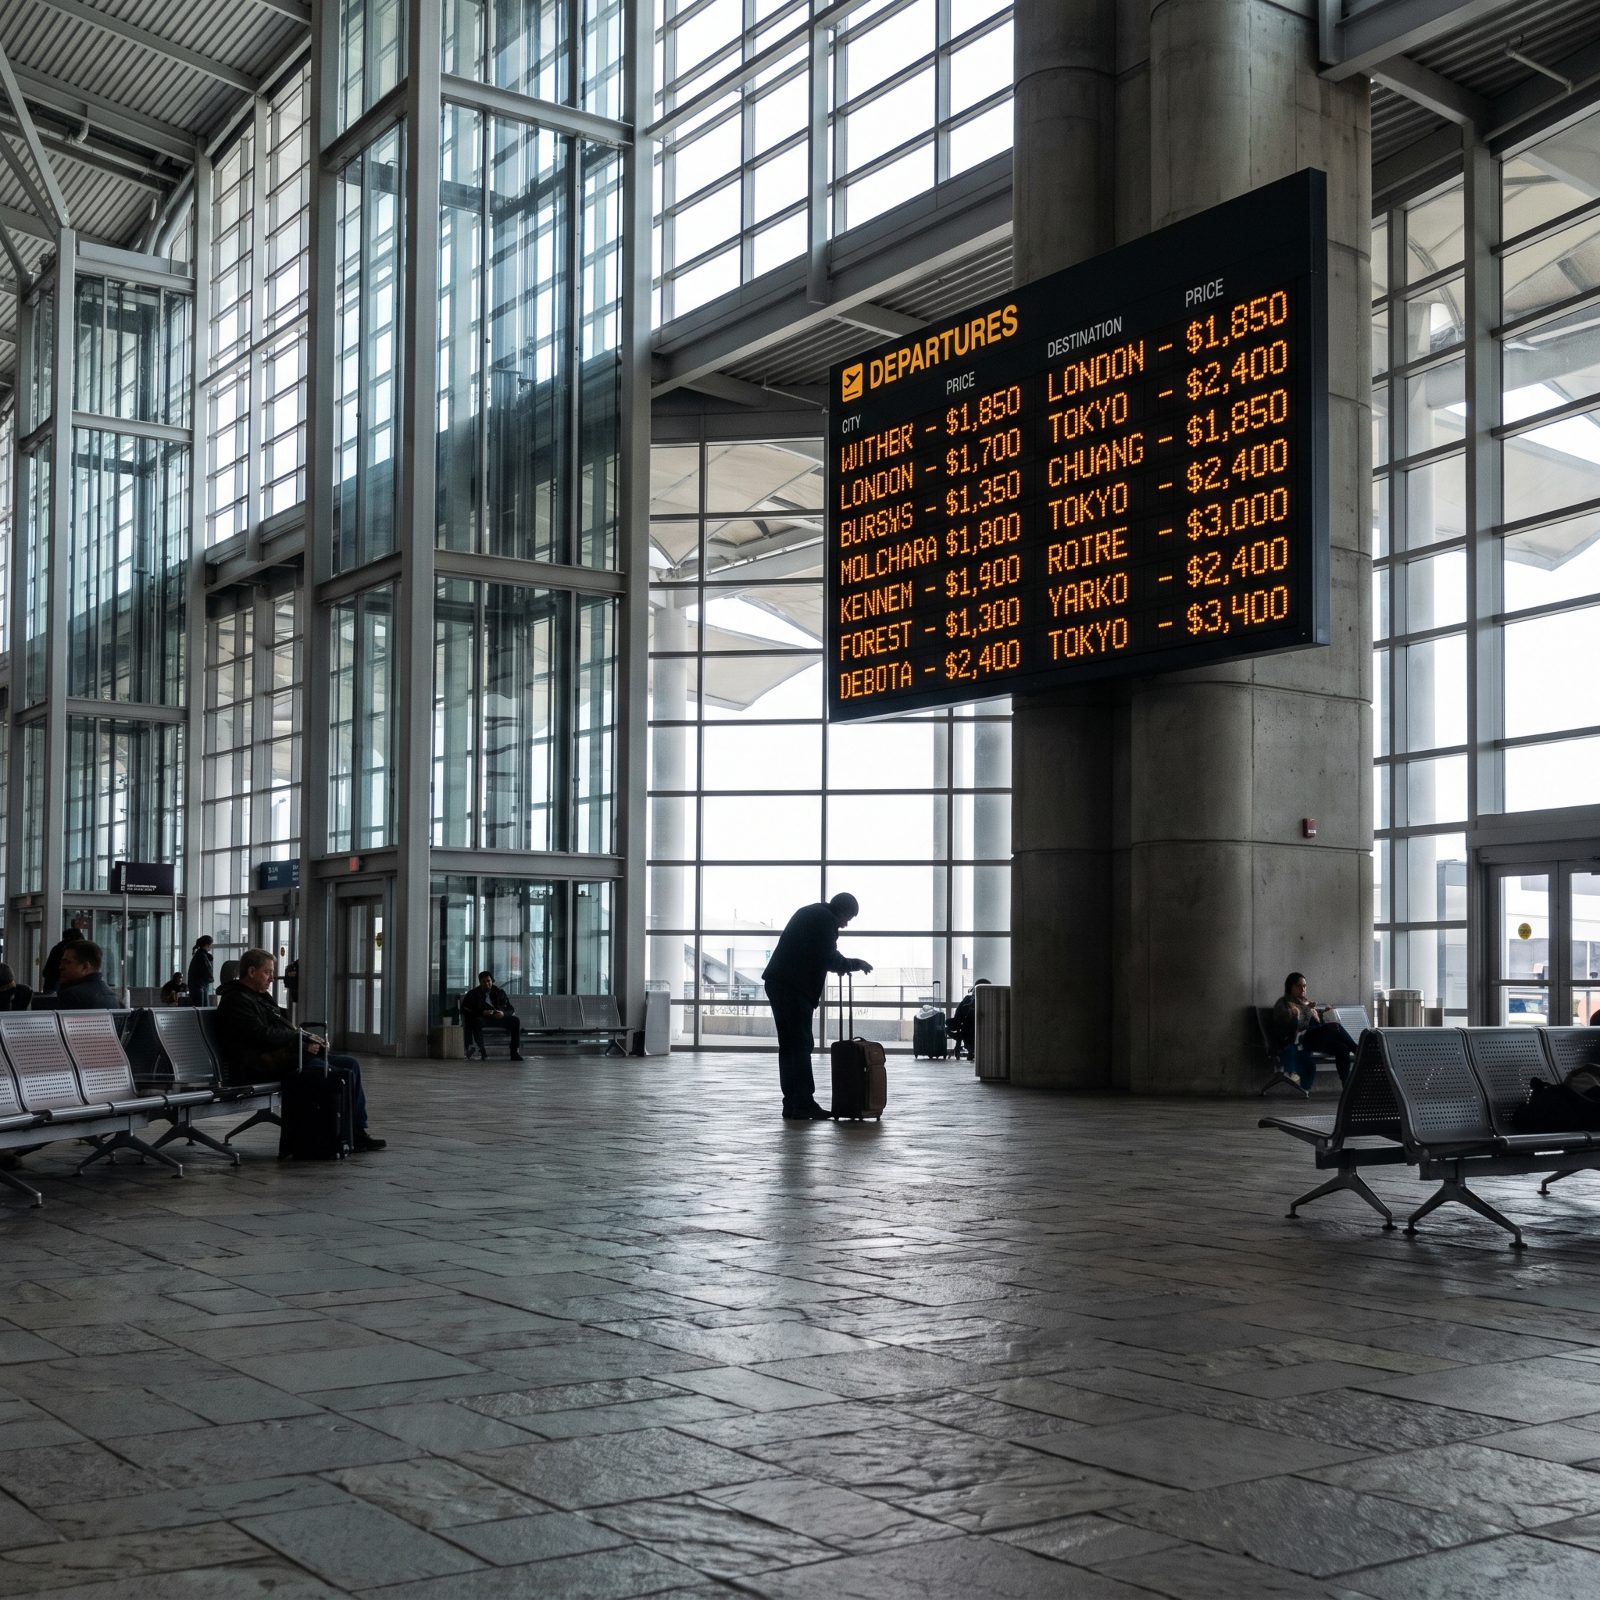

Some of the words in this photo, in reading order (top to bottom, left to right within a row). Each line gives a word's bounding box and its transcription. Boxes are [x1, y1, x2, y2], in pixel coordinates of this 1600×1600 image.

[870, 304, 1018, 389] DEPARTURES
[1048, 316, 1122, 358] DESTINATION
[1186, 278, 1224, 307] PRICE
[1049, 340, 1144, 402] LONDON
[1187, 291, 1287, 354] $1,850
[842, 415, 861, 433] CITY
[946, 371, 975, 395] PRICE
[946, 386, 1020, 435] $1,850
[1049, 392, 1127, 443] TOKYO
[1187, 340, 1287, 400] $2,400
[841, 462, 913, 509] LONDON
[946, 428, 1020, 476] $1,700
[1049, 433, 1144, 487] CHUANG
[1187, 389, 1287, 447] $1,850
[946, 470, 1020, 516] $1,350
[1049, 482, 1127, 529] TOKYO
[1187, 438, 1287, 493] $2,400
[841, 536, 937, 585] MOLCHARA
[946, 512, 1020, 556] $1,800
[1049, 527, 1127, 574] ROIRE
[1187, 487, 1287, 541] $3,000
[841, 581, 912, 623] KENNEM
[946, 555, 1020, 598] $1,900
[1049, 573, 1127, 616] YARKO
[1187, 537, 1287, 587] $2,400
[841, 620, 912, 661] FOREST
[1048, 618, 1127, 660] TOKYO
[1187, 586, 1288, 635] $3,400
[841, 661, 912, 699] DEBOTA
[946, 640, 1020, 679] $2,400
